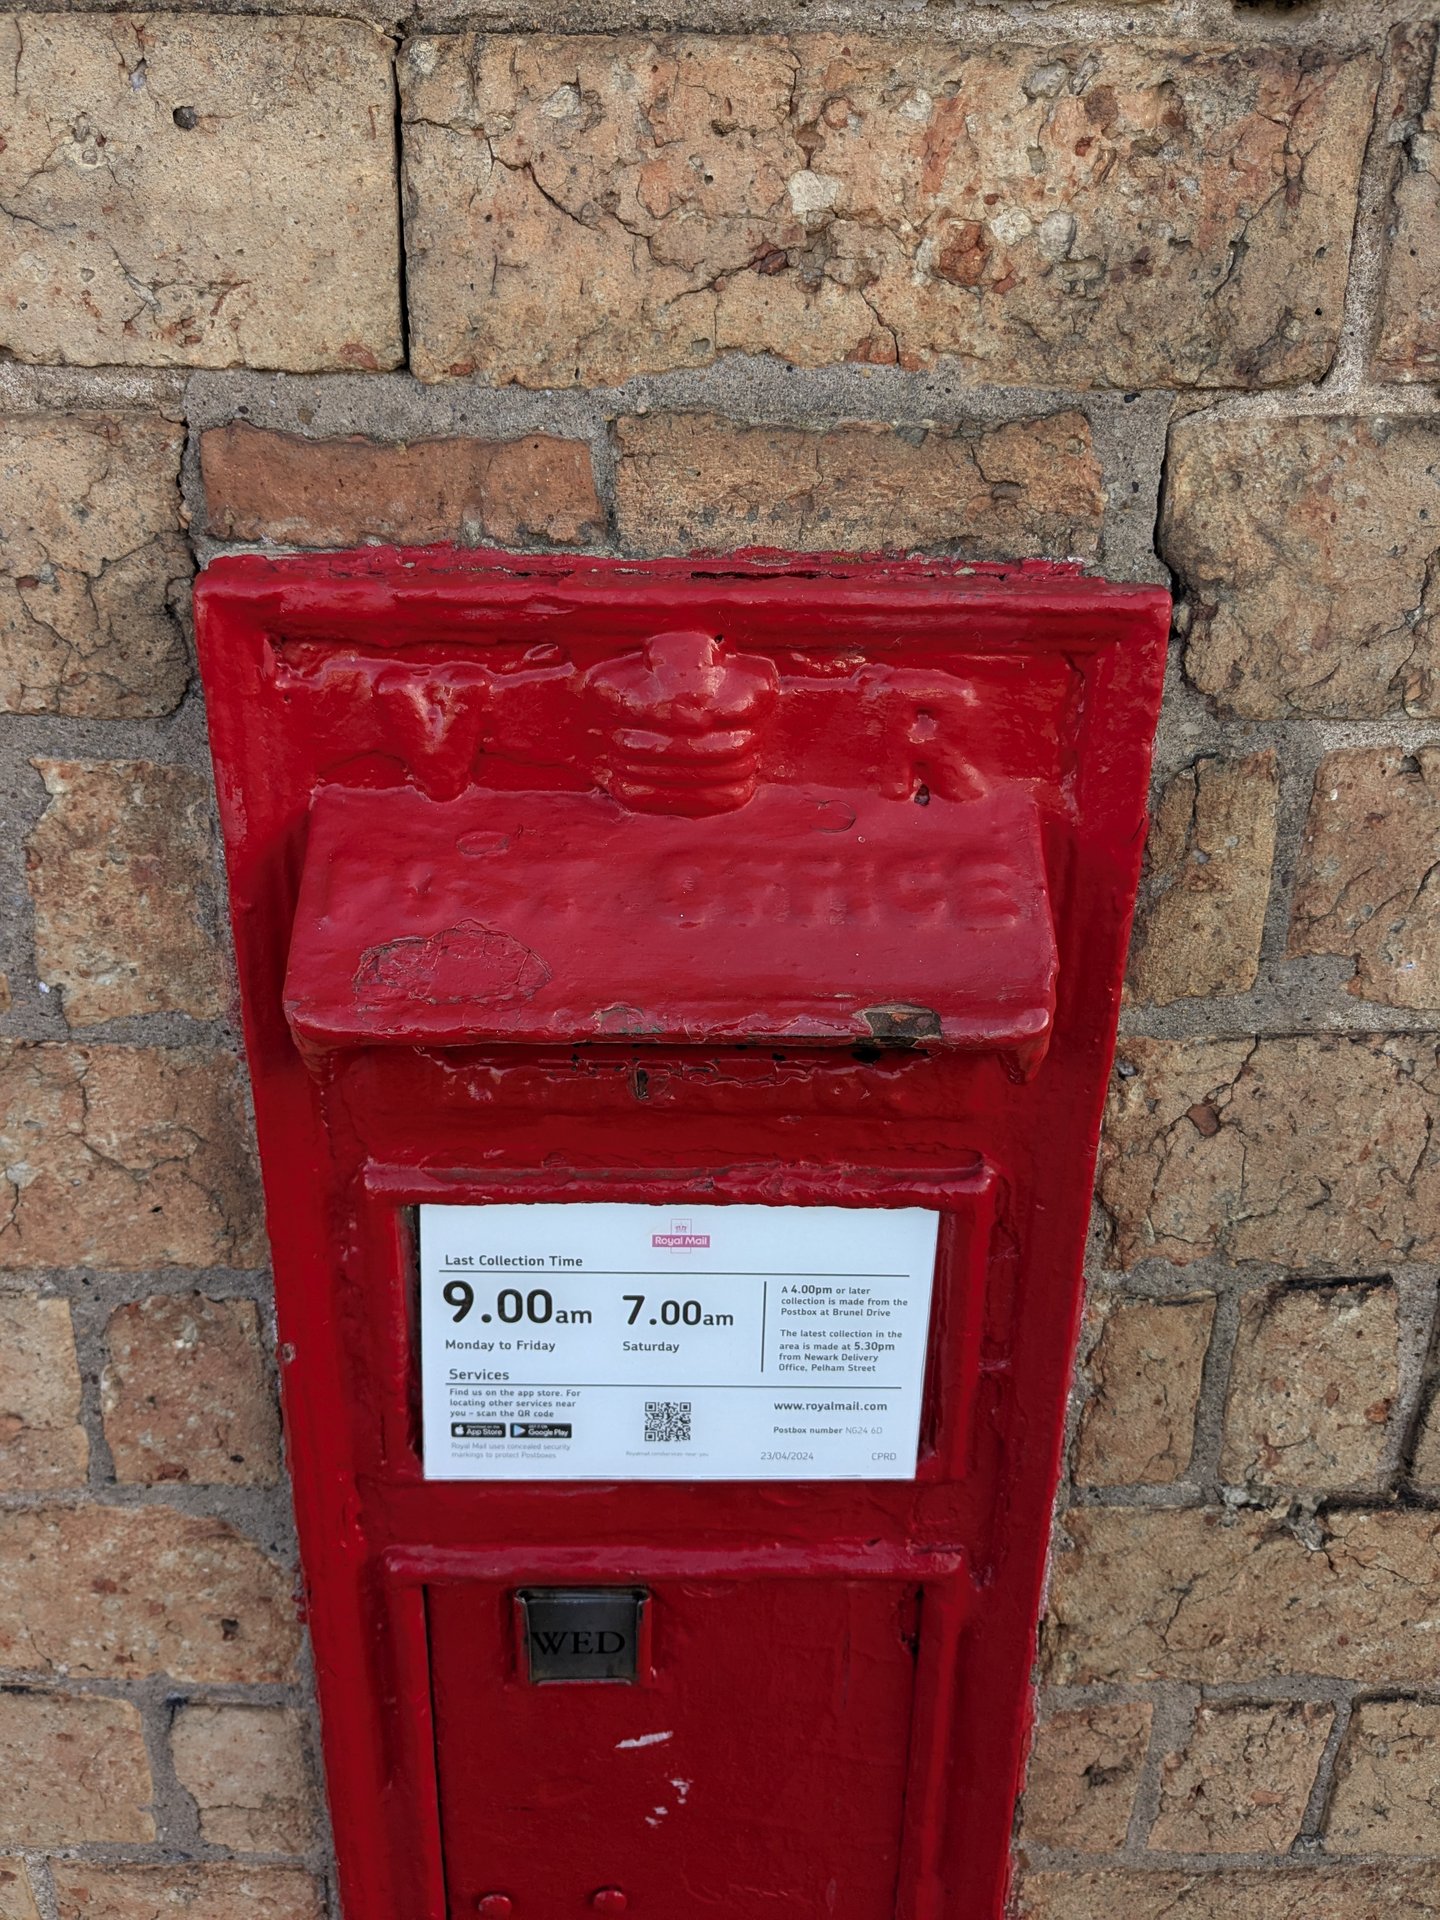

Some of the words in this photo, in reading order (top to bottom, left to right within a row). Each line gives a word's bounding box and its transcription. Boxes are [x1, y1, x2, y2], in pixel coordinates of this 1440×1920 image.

[655, 1236, 683, 1246] Royal
[685, 1237, 707, 1245] Mail
[445, 1255, 474, 1265] Last
[479, 1255, 545, 1266] Collection
[549, 1256, 583, 1267] Time
[782, 1286, 788, 1294] A
[791, 1285, 832, 1295] 4.00pm
[849, 1287, 871, 1295] later
[443, 1280, 592, 1324] 9.00am
[622, 1295, 734, 1326] 7.00am
[781, 1308, 817, 1316] Postbox
[867, 1309, 891, 1317] Drive
[780, 1329, 797, 1337] The
[829, 1330, 872, 1338] collection
[445, 1340, 495, 1351] Monday
[499, 1341, 512, 1350] to
[517, 1340, 556, 1352] Friday
[623, 1341, 680, 1353] Saturday
[854, 1342, 895, 1352] 5.30pm
[841, 1354, 879, 1362] Delivery
[779, 1364, 808, 1372] Office,
[811, 1364, 844, 1372] Pelham
[449, 1369, 510, 1380] Services
[449, 1388, 469, 1396] Find
[518, 1390, 534, 1398] app
[566, 1389, 581, 1397] For
[450, 1399, 485, 1408] locating
[489, 1399, 512, 1407] other
[774, 1401, 887, 1412] www.royalmail.com
[450, 1410, 466, 1418] you
[543, 1443, 570, 1451] security
[761, 1452, 813, 1460] 23/04/2024
[531, 1631, 625, 1655] WED
